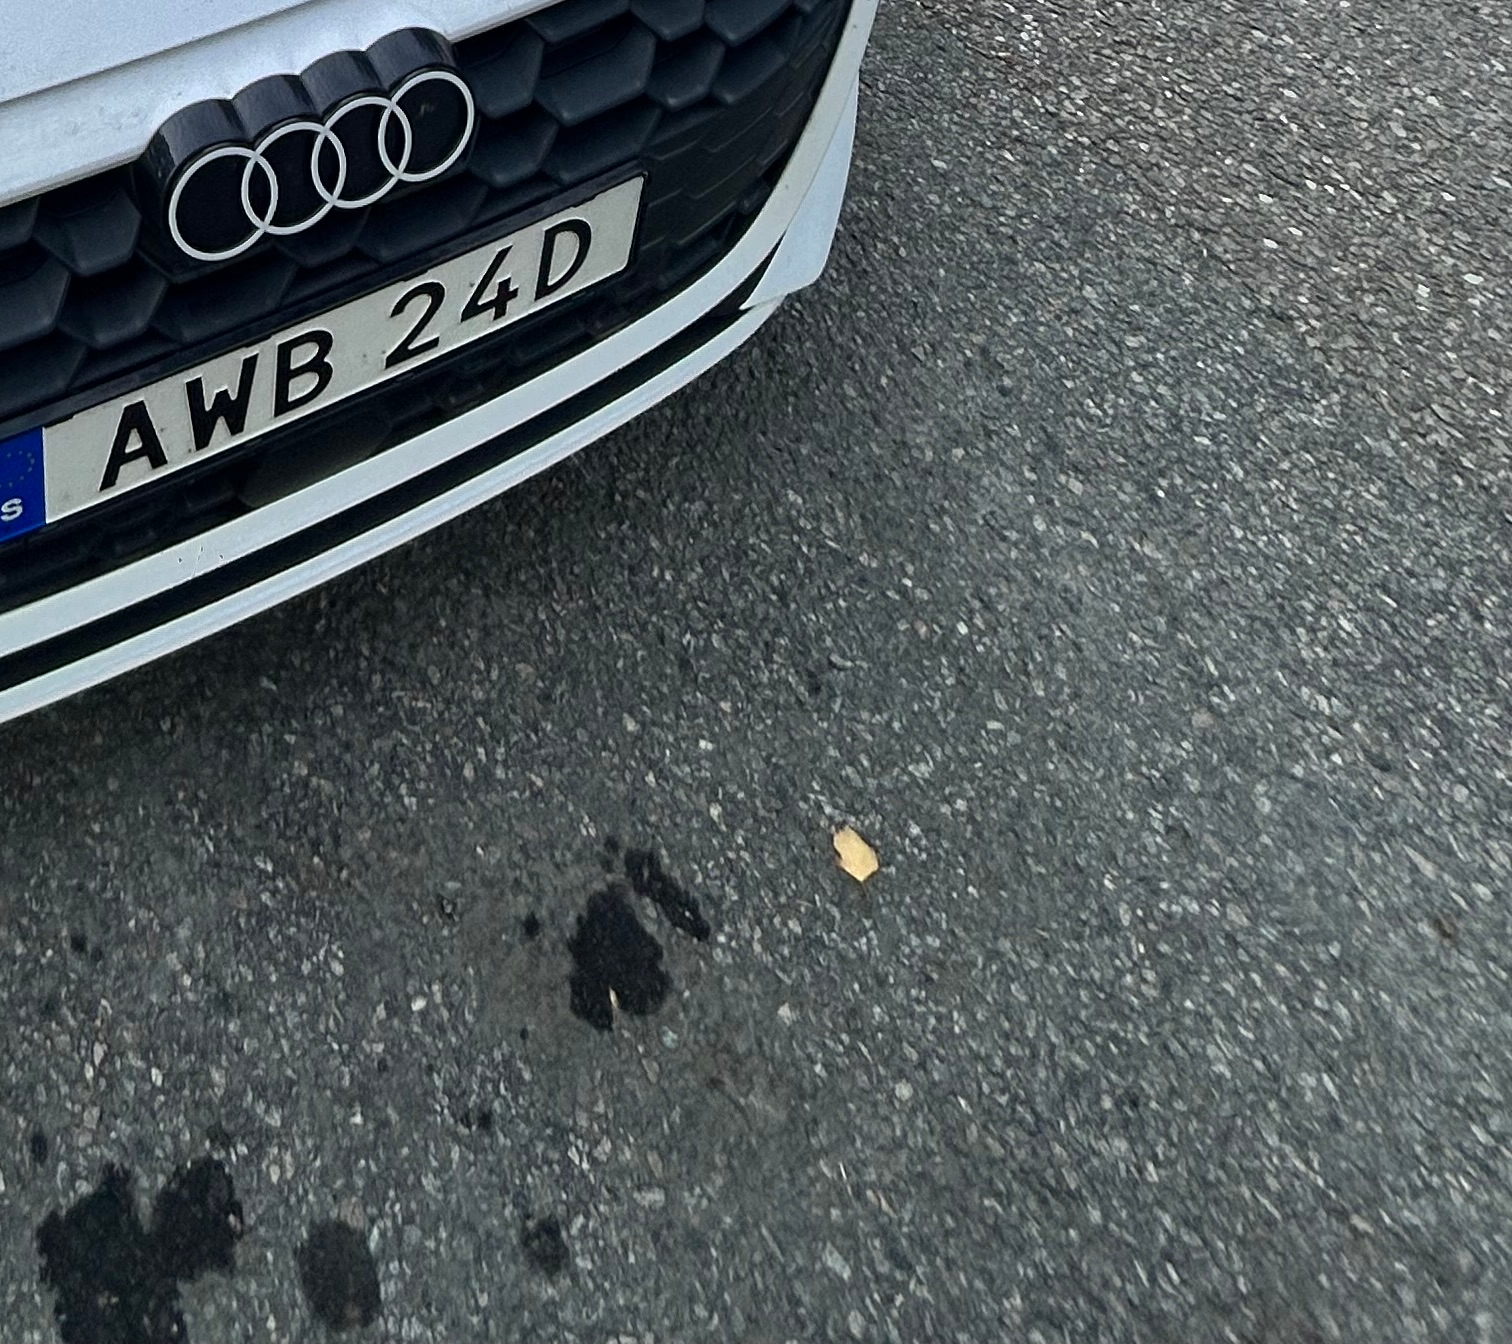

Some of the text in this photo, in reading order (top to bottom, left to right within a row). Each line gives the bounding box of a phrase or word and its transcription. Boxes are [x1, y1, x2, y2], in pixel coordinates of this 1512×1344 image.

[98, 219, 592, 491] AWB 24D
[0, 498, 23, 523] S
